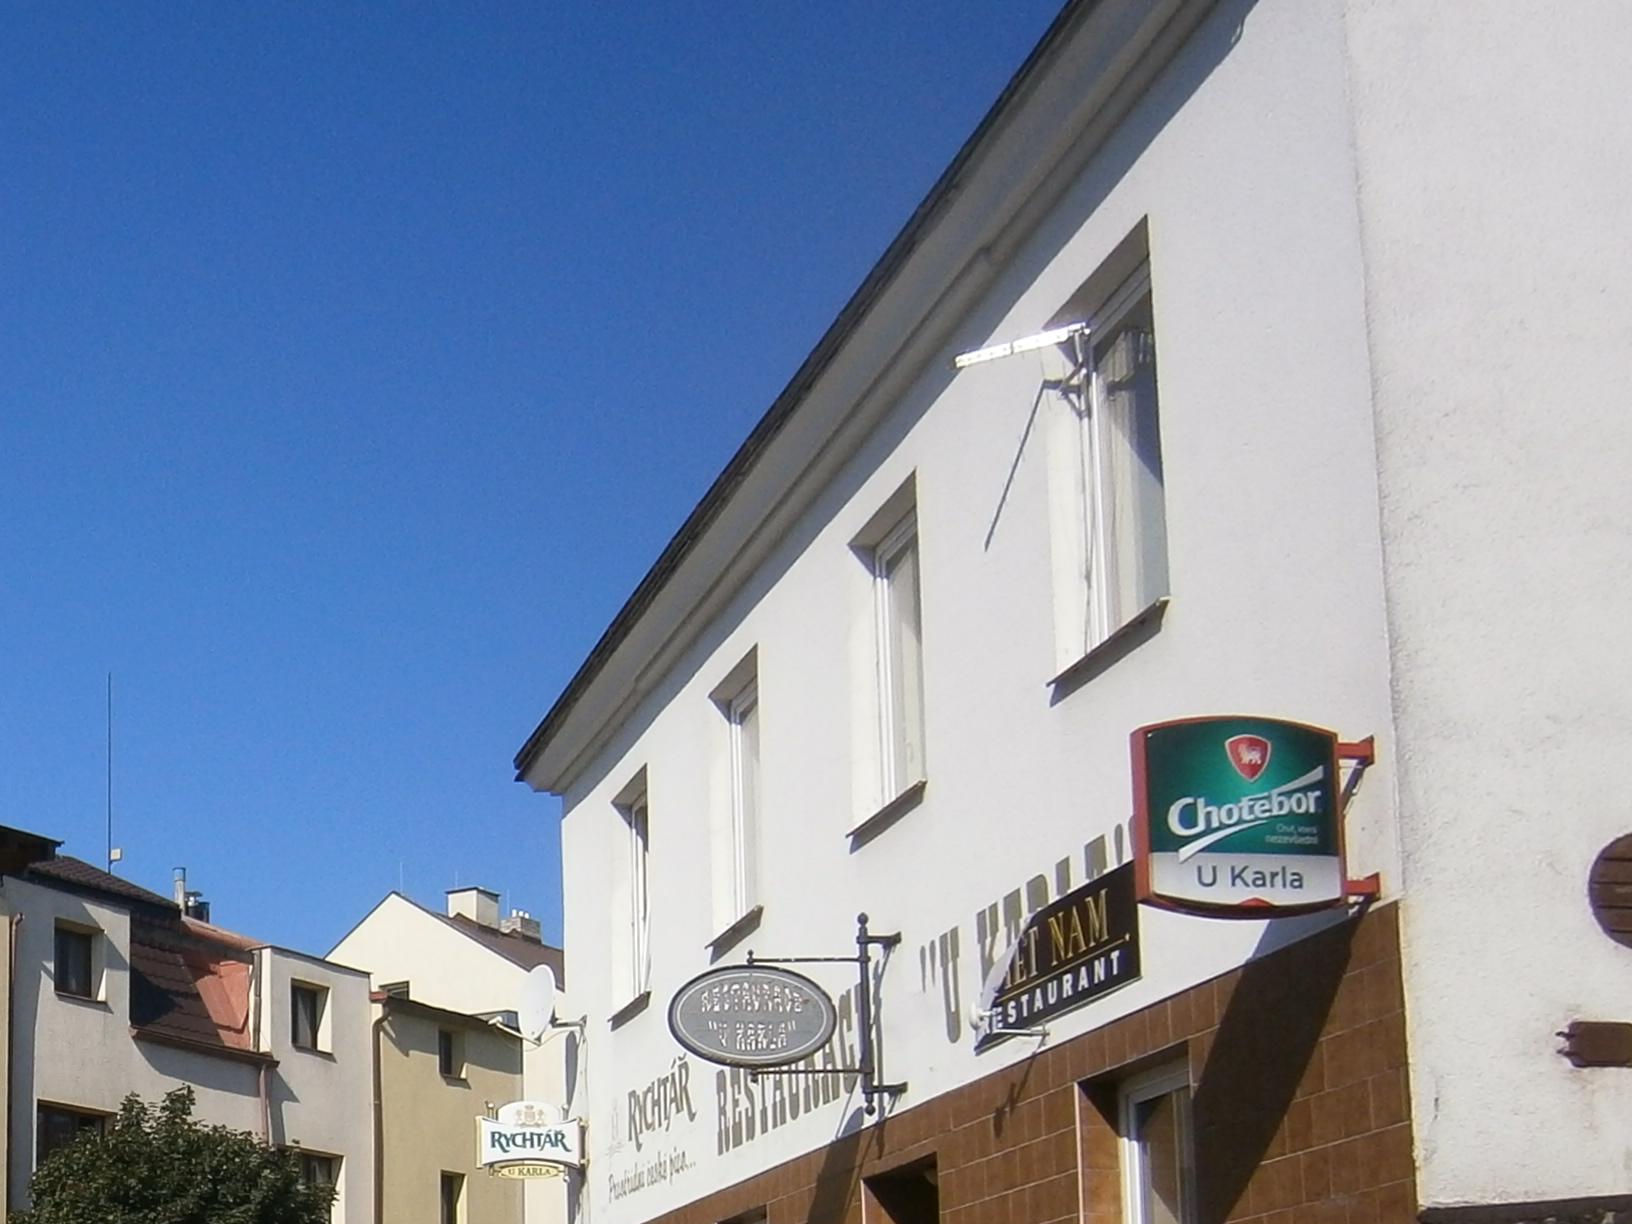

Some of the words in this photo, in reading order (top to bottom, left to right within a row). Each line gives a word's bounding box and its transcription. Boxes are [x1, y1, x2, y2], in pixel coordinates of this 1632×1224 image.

[1197, 865, 1217, 888] U
[1230, 865, 1304, 889] Karla
[1048, 887, 1110, 966] NAM
[628, 1053, 697, 1153] RYCHTÁŘ
[490, 1129, 573, 1153] RYCHTÁŘ
[508, 1167, 516, 1176] U
[517, 1167, 551, 1176] KARLA
